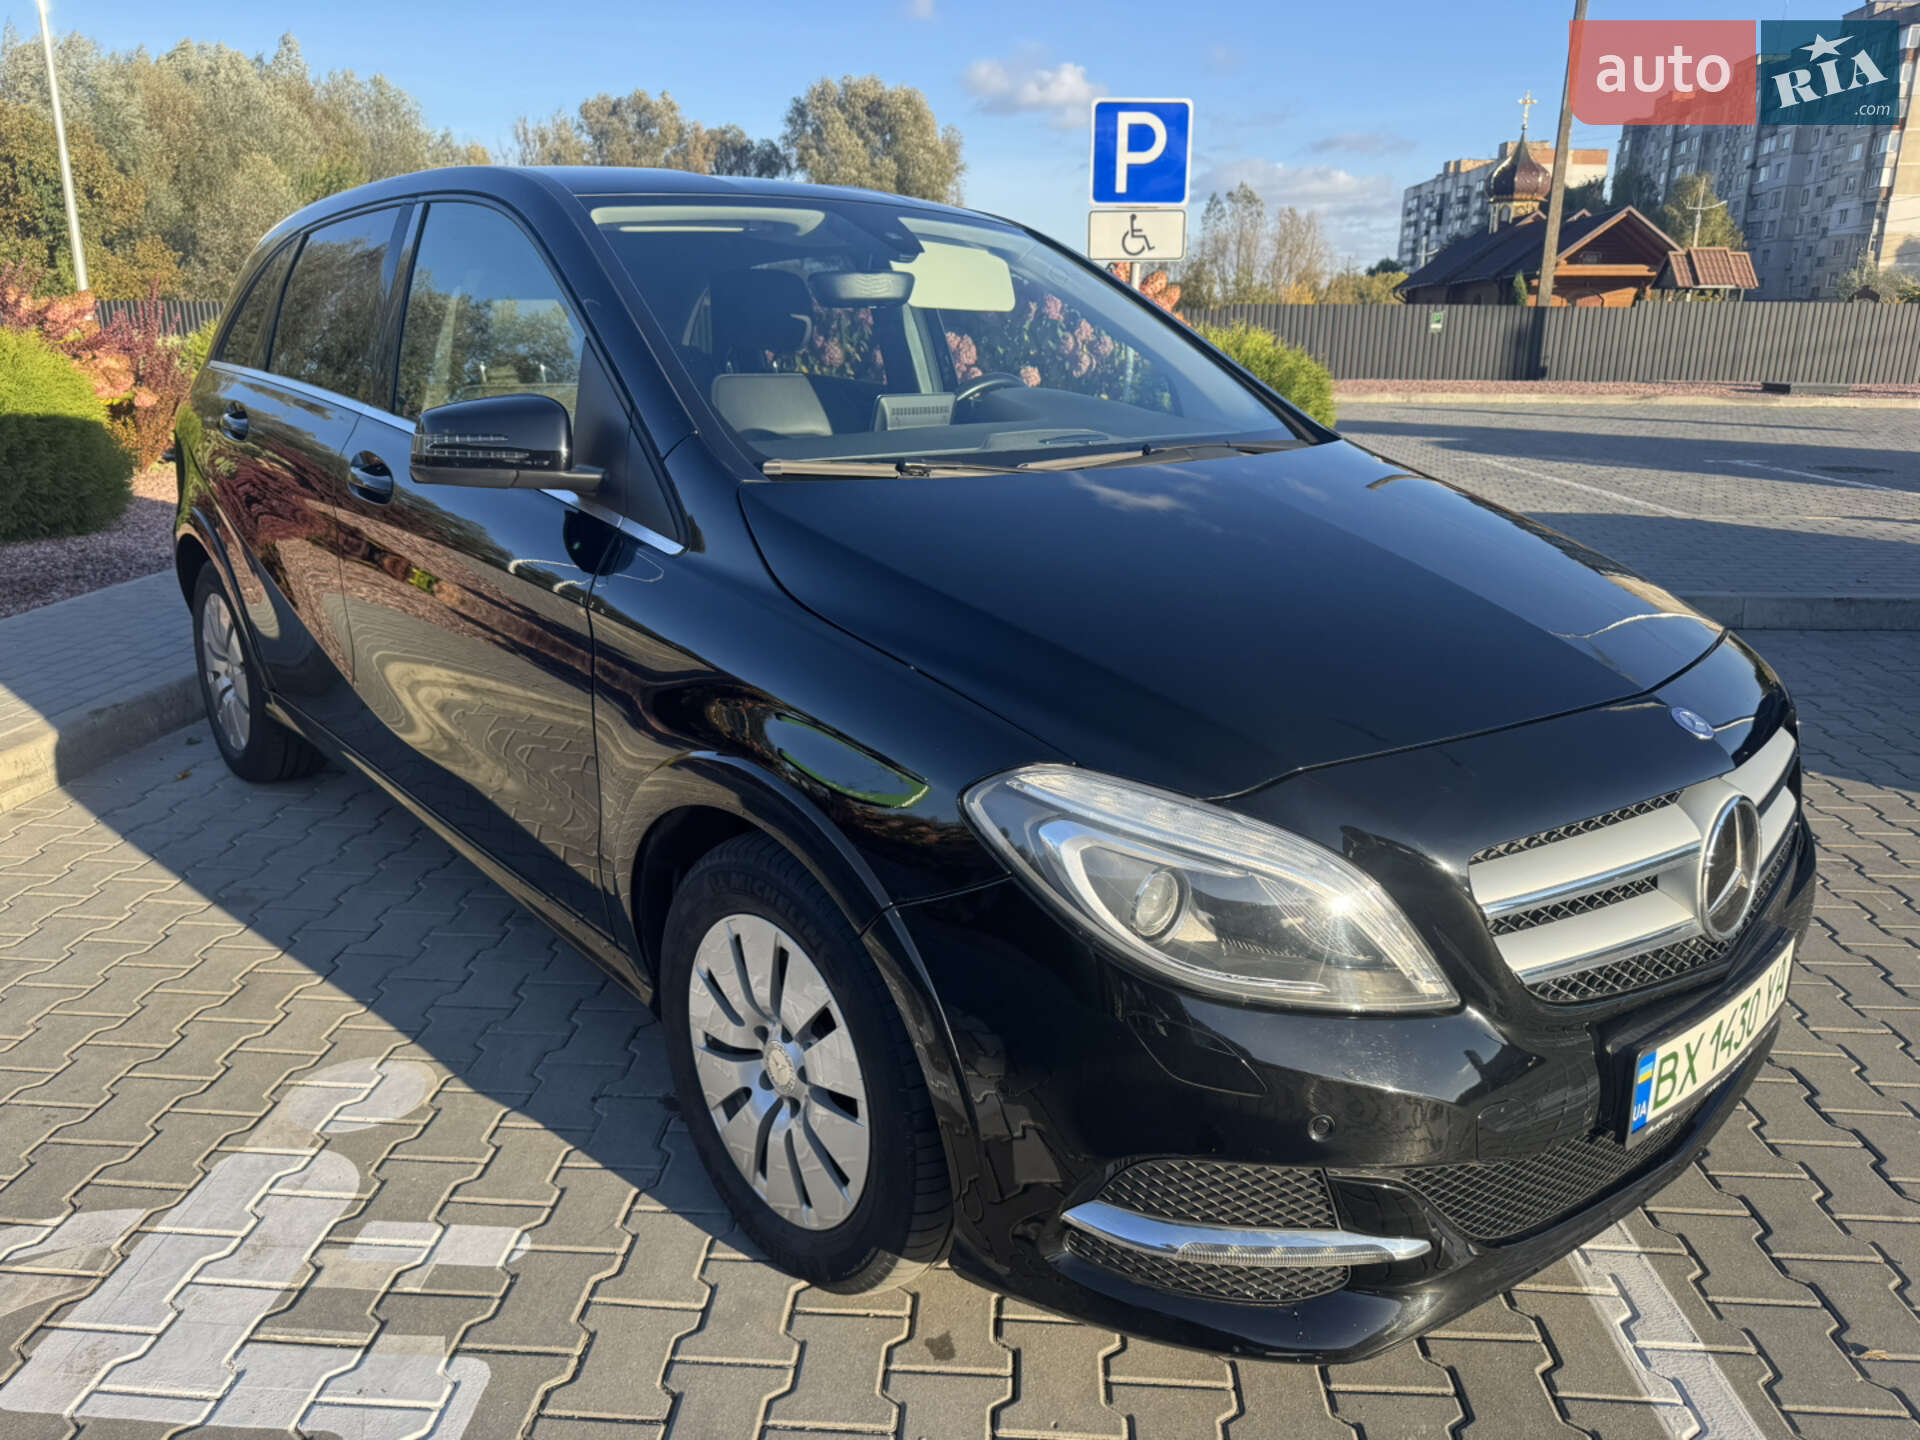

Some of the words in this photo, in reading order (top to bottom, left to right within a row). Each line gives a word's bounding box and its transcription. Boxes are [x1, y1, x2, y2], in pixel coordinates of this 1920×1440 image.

[1115, 111, 1167, 194] P
[1652, 1032, 1705, 1111] BX
[1709, 987, 1761, 1071] 1430
[1632, 1100, 1647, 1121] UA
